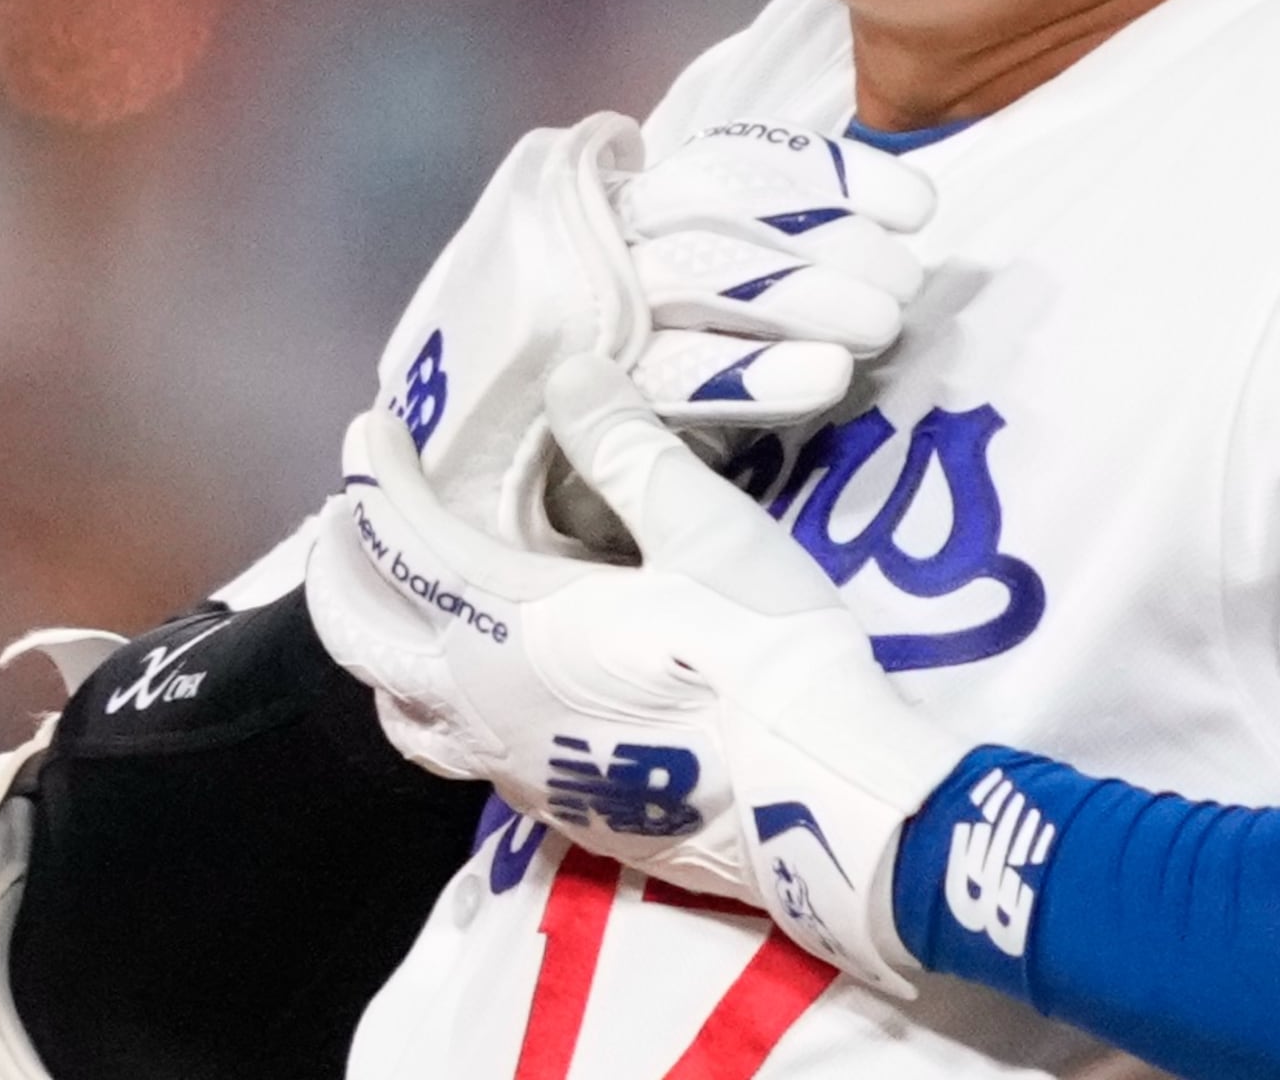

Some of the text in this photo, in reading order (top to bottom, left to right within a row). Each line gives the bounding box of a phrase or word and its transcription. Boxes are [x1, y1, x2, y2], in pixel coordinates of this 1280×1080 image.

[353, 501, 509, 644] new balance
[546, 735, 704, 837] NB
[944, 767, 1056, 957] NB
[513, 842, 841, 1080] 17
